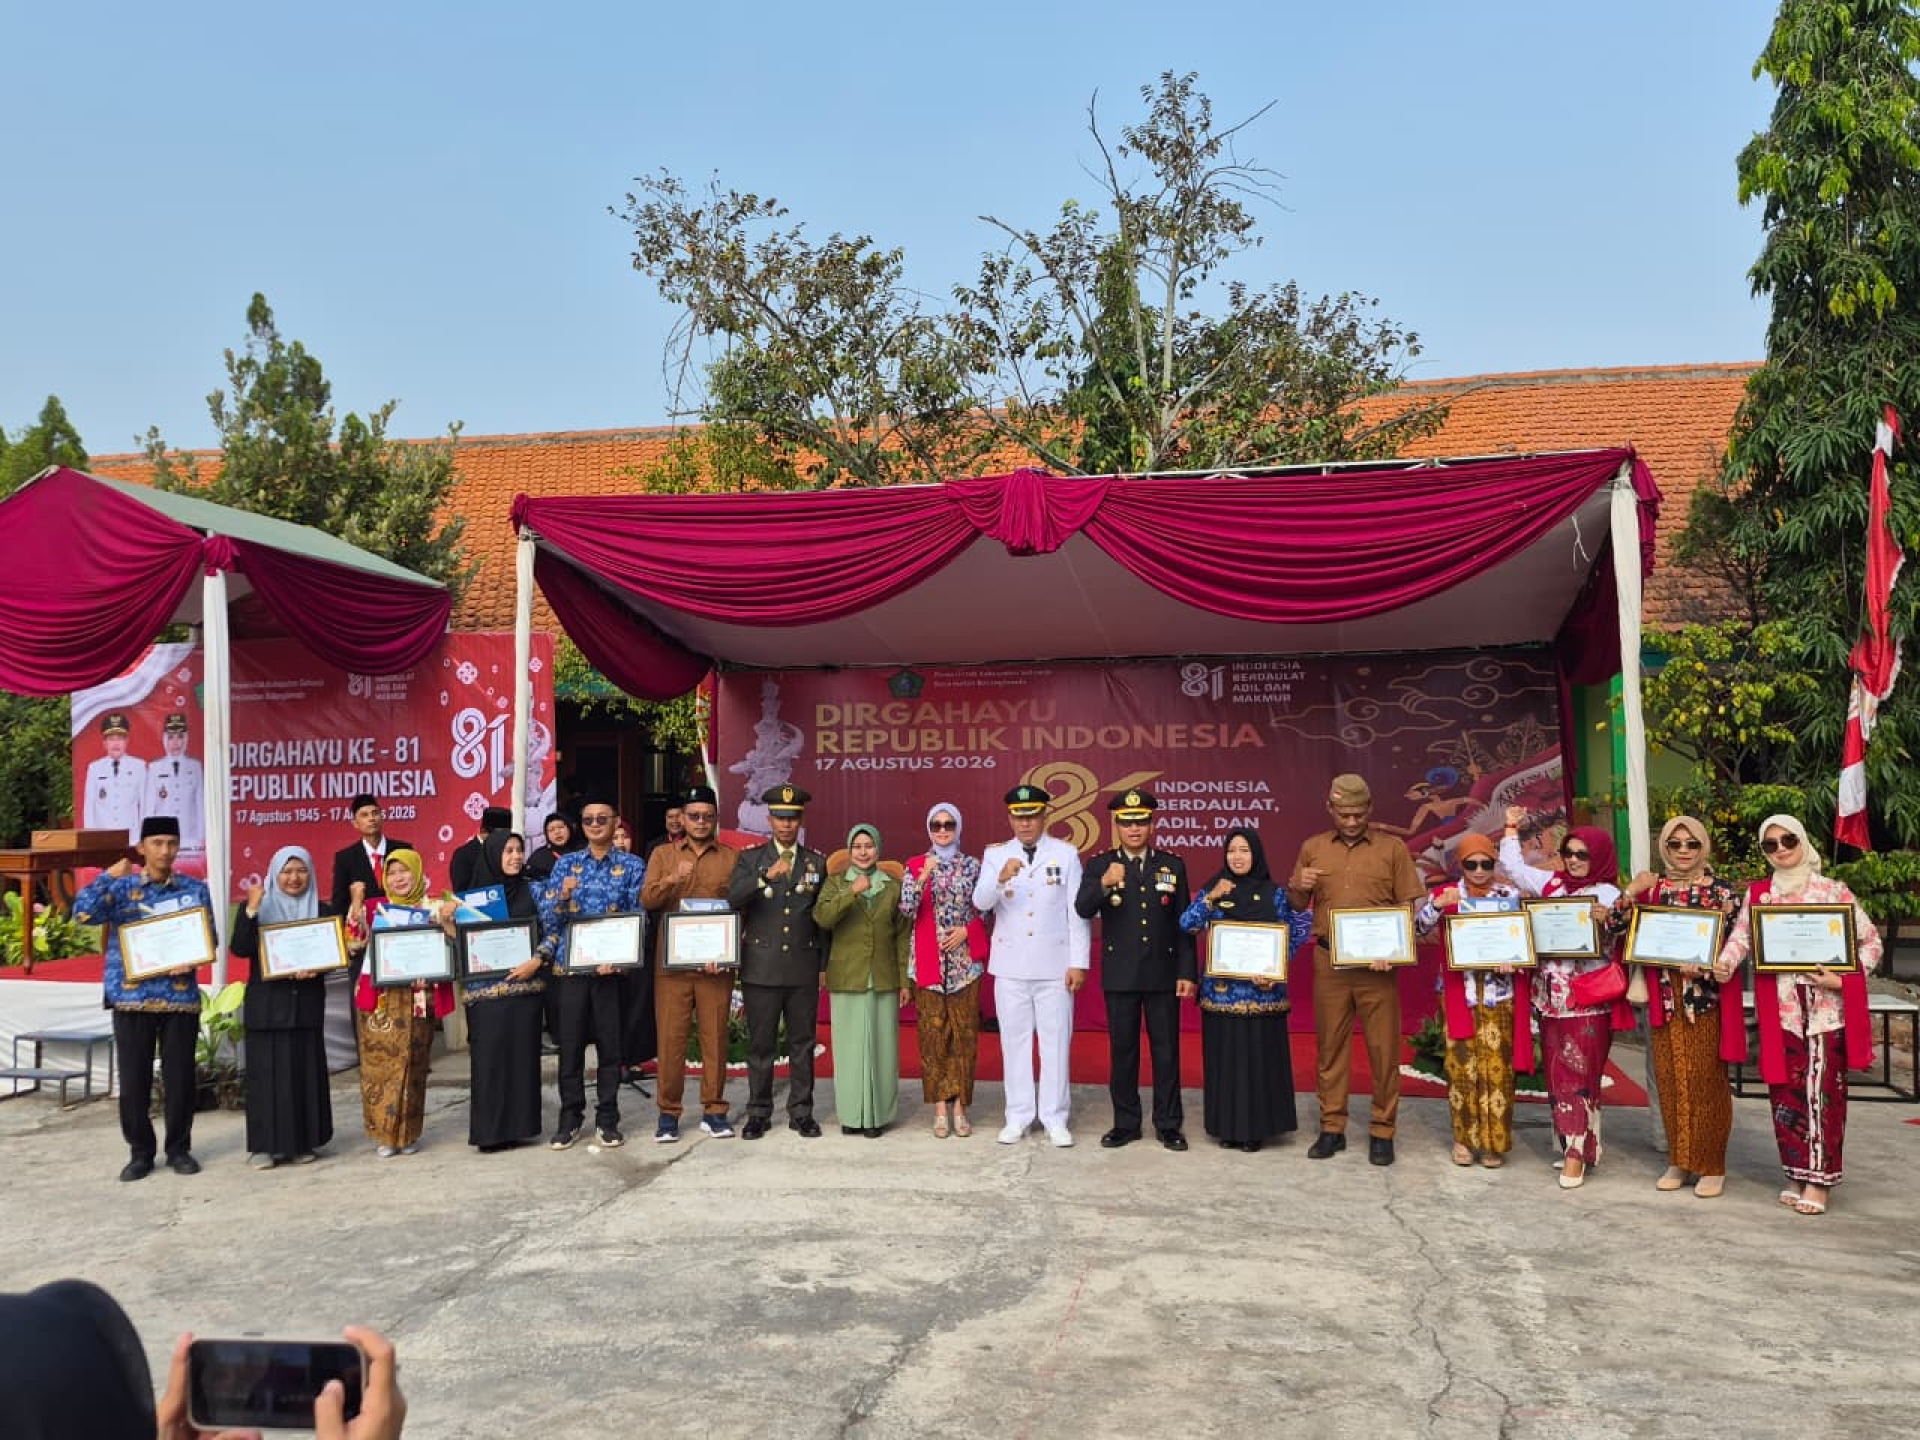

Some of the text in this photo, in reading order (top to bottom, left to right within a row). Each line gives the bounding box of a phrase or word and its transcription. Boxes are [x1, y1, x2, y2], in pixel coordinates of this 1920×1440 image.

[1232, 684, 1261, 692] ADIL
[816, 700, 1057, 727] DIRGAHAYU
[816, 723, 1265, 754] REPUBLIK INDONESIA
[348, 737, 376, 764] KE
[395, 736, 421, 763] 81
[816, 755, 996, 771] 17 AGUSTUS 2026
[229, 769, 436, 800] EPUBLIK INDONESIA
[1155, 781, 1270, 793] INDONESIA
[388, 805, 416, 819] 2026
[1156, 799, 1280, 812] BERDAULAT,
[236, 810, 248, 823] 17
[249, 808, 292, 825] Agustus
[295, 807, 321, 822] 1945
[330, 807, 342, 820] 17
[1156, 816, 1260, 831] ADIL, DAN
[1156, 834, 1226, 847] MAKM
